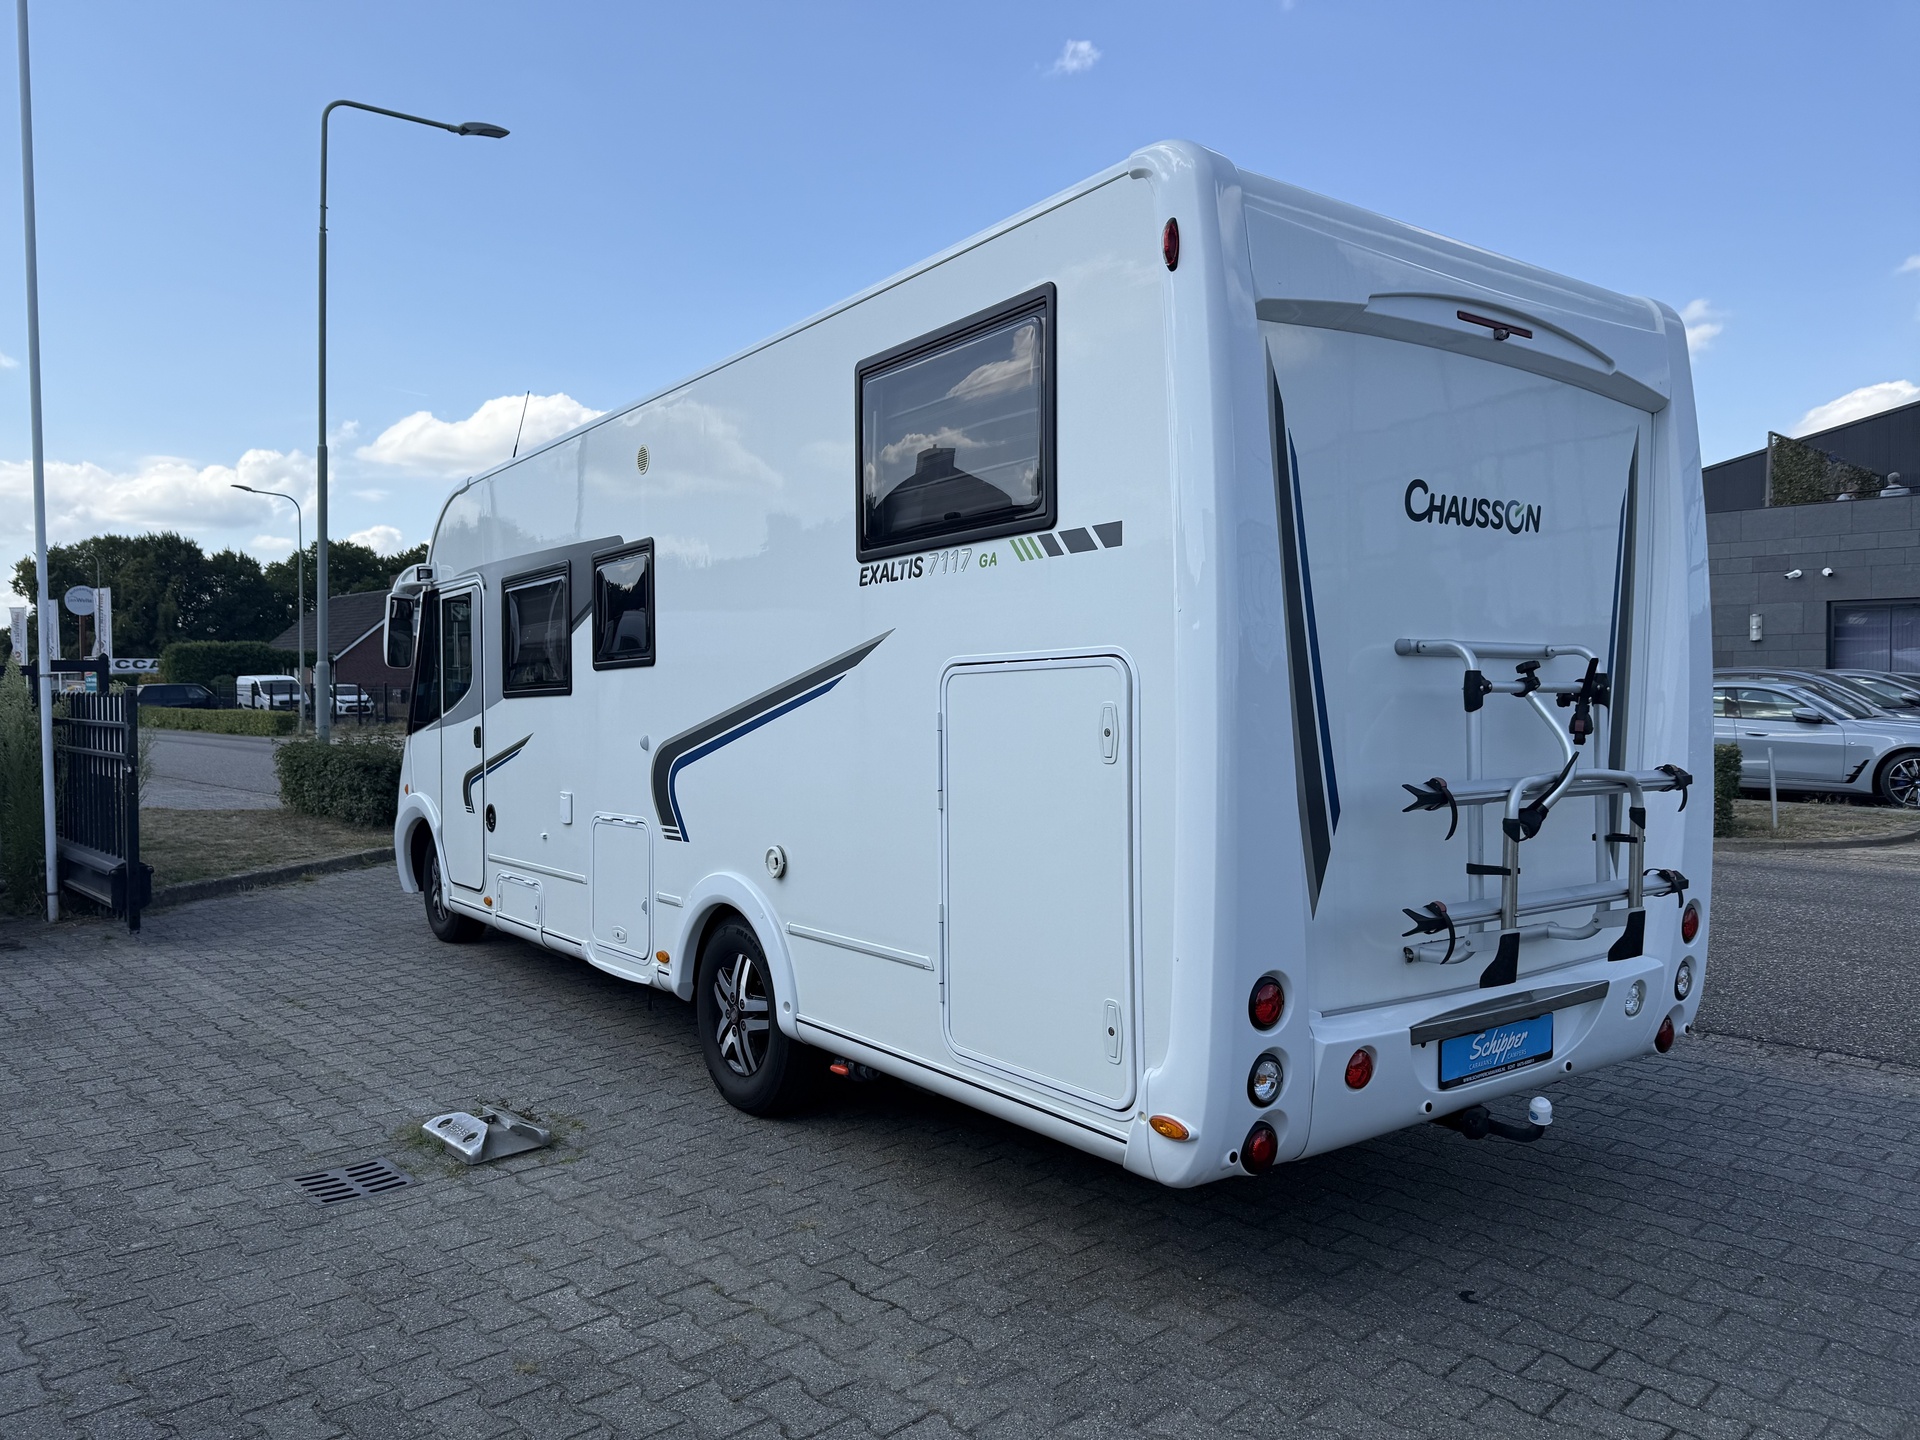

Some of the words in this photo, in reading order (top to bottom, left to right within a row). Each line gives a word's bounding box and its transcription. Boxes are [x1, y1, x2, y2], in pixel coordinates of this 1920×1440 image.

[1404, 478, 1542, 535] CHAUSSON
[859, 556, 924, 587] EXALTIS
[928, 547, 973, 576] 7117
[978, 553, 998, 569] GA
[1468, 1058, 1493, 1071] CARAVANS
[1507, 1049, 1527, 1060] CAMPERS
[1469, 1028, 1529, 1066] Schipper
